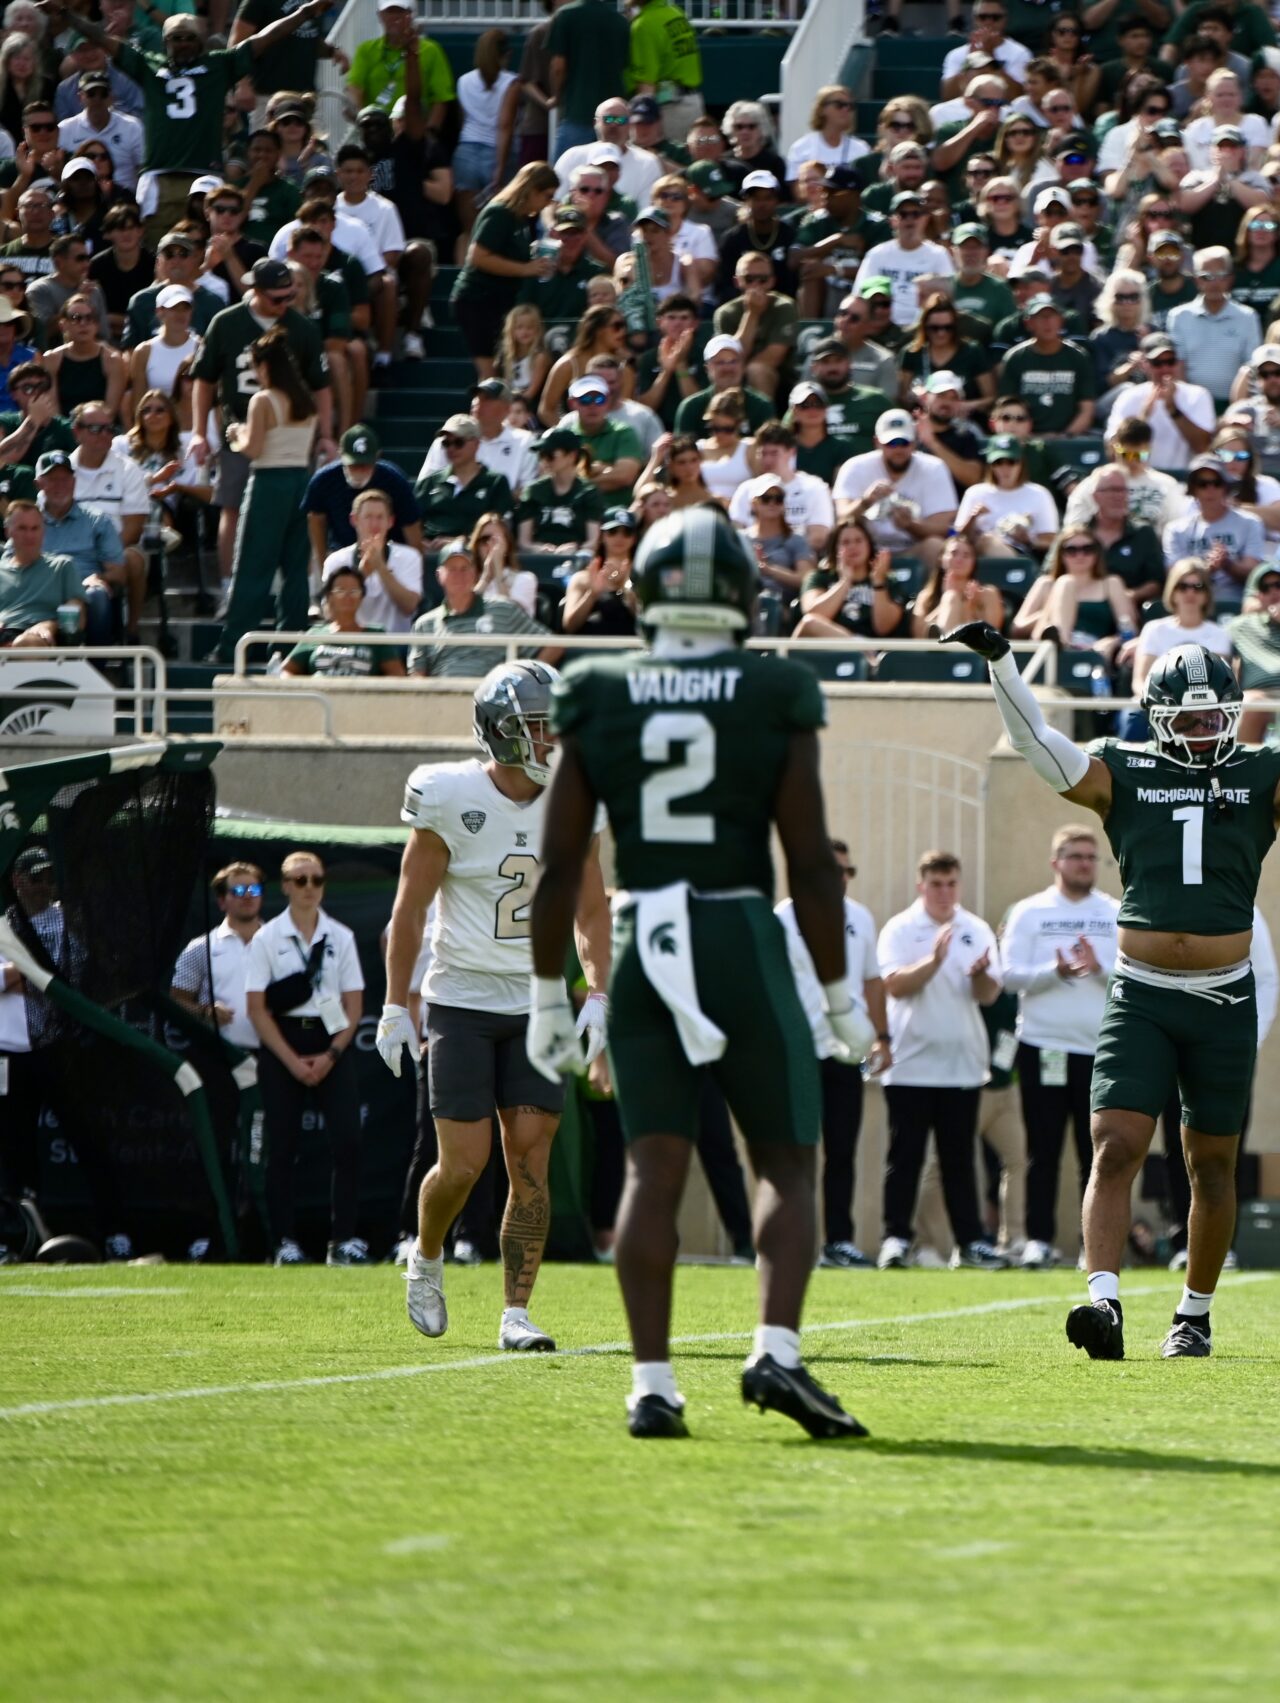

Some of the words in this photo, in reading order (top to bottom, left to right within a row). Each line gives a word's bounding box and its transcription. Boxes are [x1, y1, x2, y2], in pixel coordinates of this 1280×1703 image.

[165, 77, 197, 119] 3
[626, 667, 742, 703] VAUGHT
[641, 711, 716, 842] 2
[1137, 787, 1205, 803] MICHIGAN
[1172, 806, 1204, 885] 1
[494, 853, 539, 940] 2
